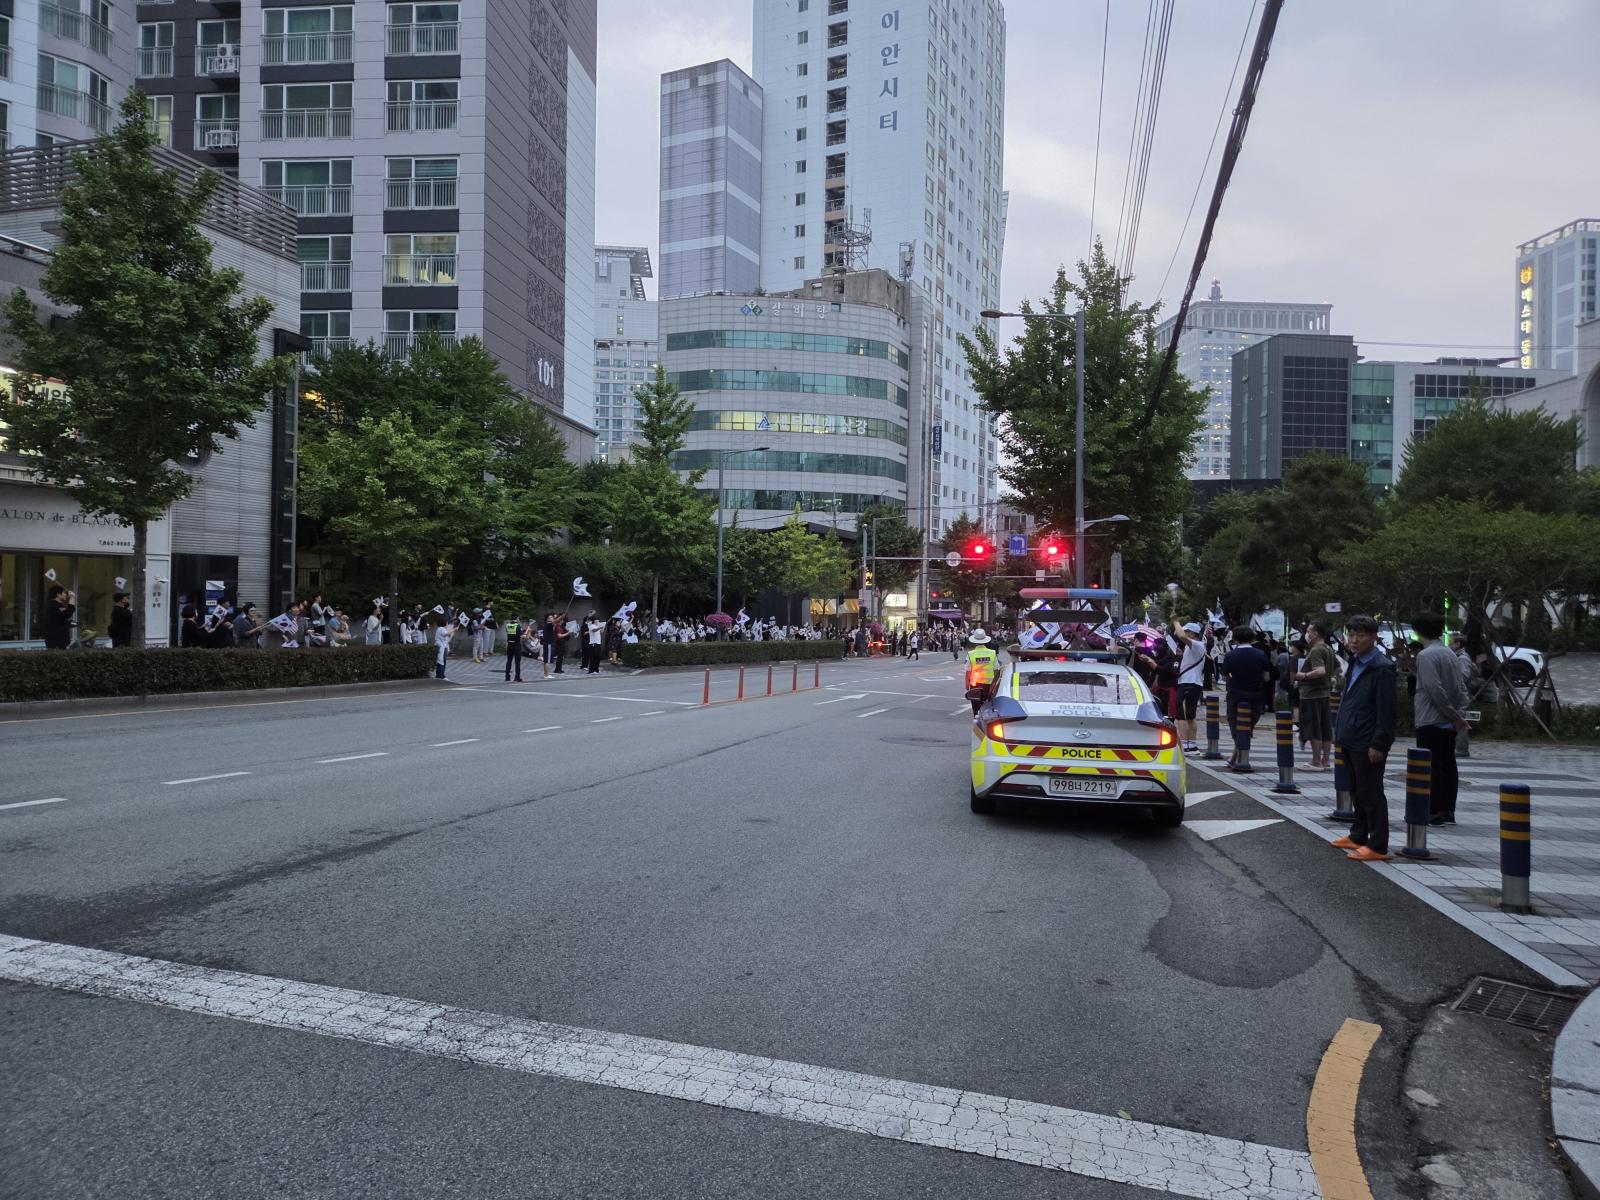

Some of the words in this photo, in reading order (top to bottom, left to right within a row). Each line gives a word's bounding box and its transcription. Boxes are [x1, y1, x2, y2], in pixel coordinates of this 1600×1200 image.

[879, 9, 901, 131] 이안시티
[537, 357, 554, 389] 101
[52, 512, 64, 522] de
[1062, 748, 1102, 759] POLICE
[1084, 781, 1112, 793] 2219
